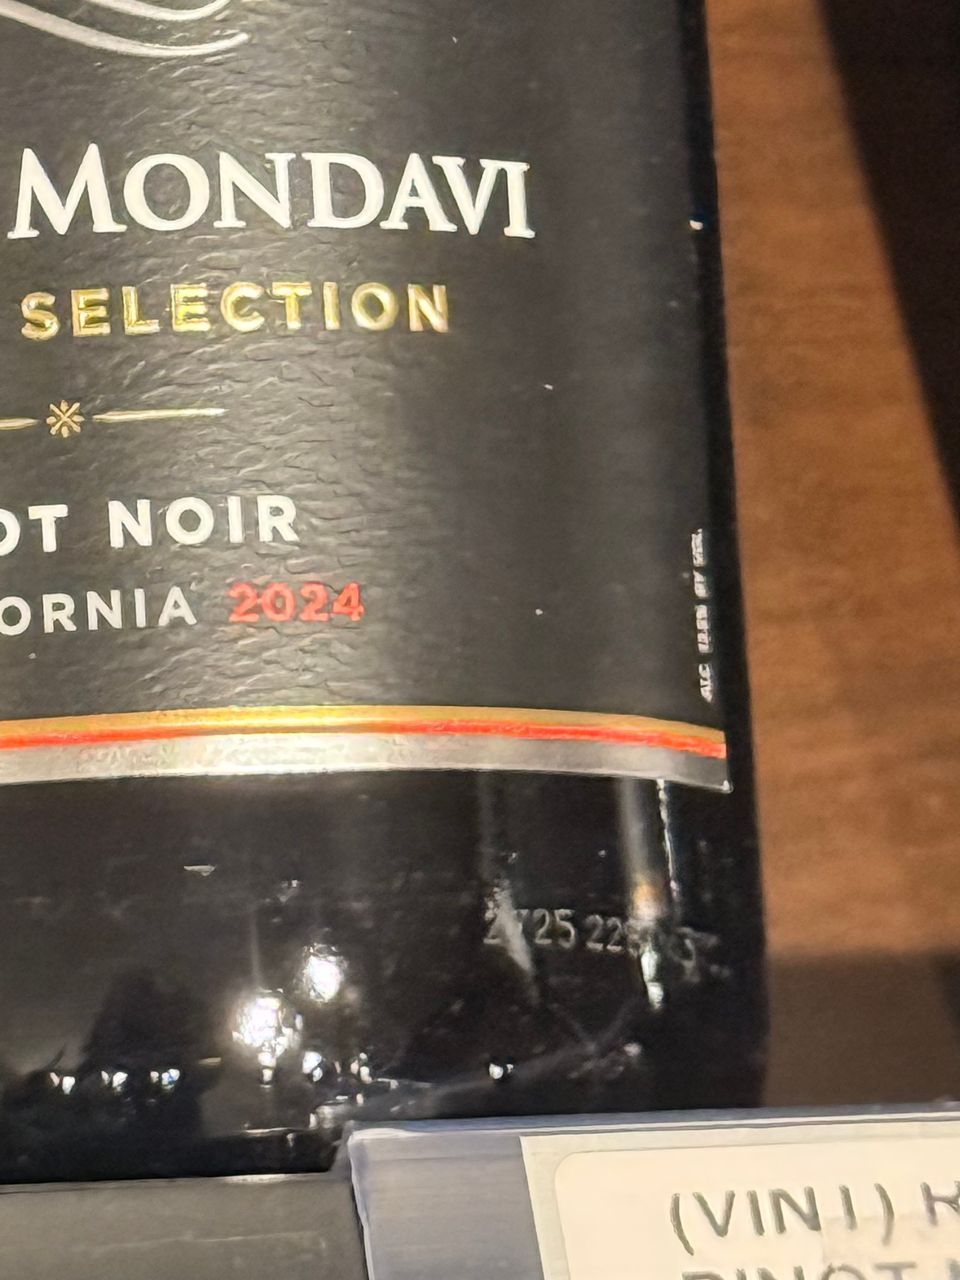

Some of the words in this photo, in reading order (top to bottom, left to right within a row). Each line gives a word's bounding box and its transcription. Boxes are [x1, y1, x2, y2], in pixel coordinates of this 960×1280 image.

[6, 142, 536, 239] MONDAVI
[20, 281, 450, 341] SELECTION
[107, 493, 300, 549] NOIR
[226, 581, 365, 623] 2024
